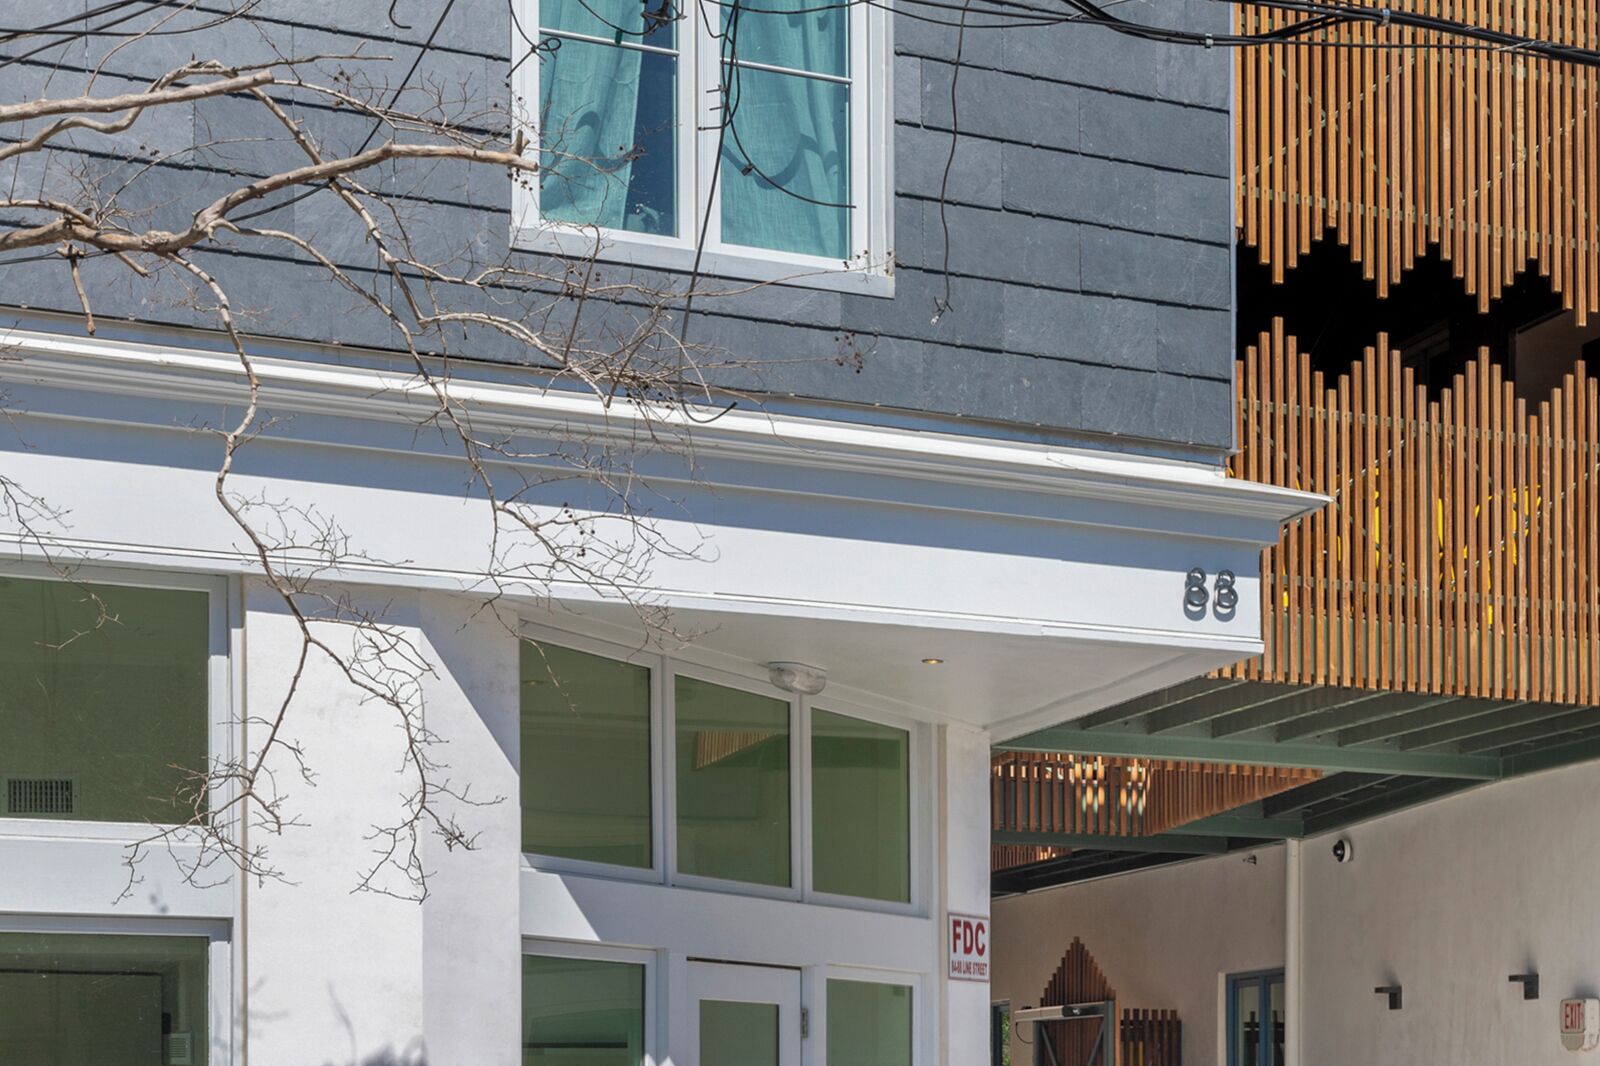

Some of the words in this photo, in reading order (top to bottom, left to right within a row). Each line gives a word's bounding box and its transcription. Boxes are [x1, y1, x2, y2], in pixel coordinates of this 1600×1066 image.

[1185, 567, 1238, 614] 88
[952, 919, 986, 957] FDC
[1564, 1002, 1581, 1030] EXIT
